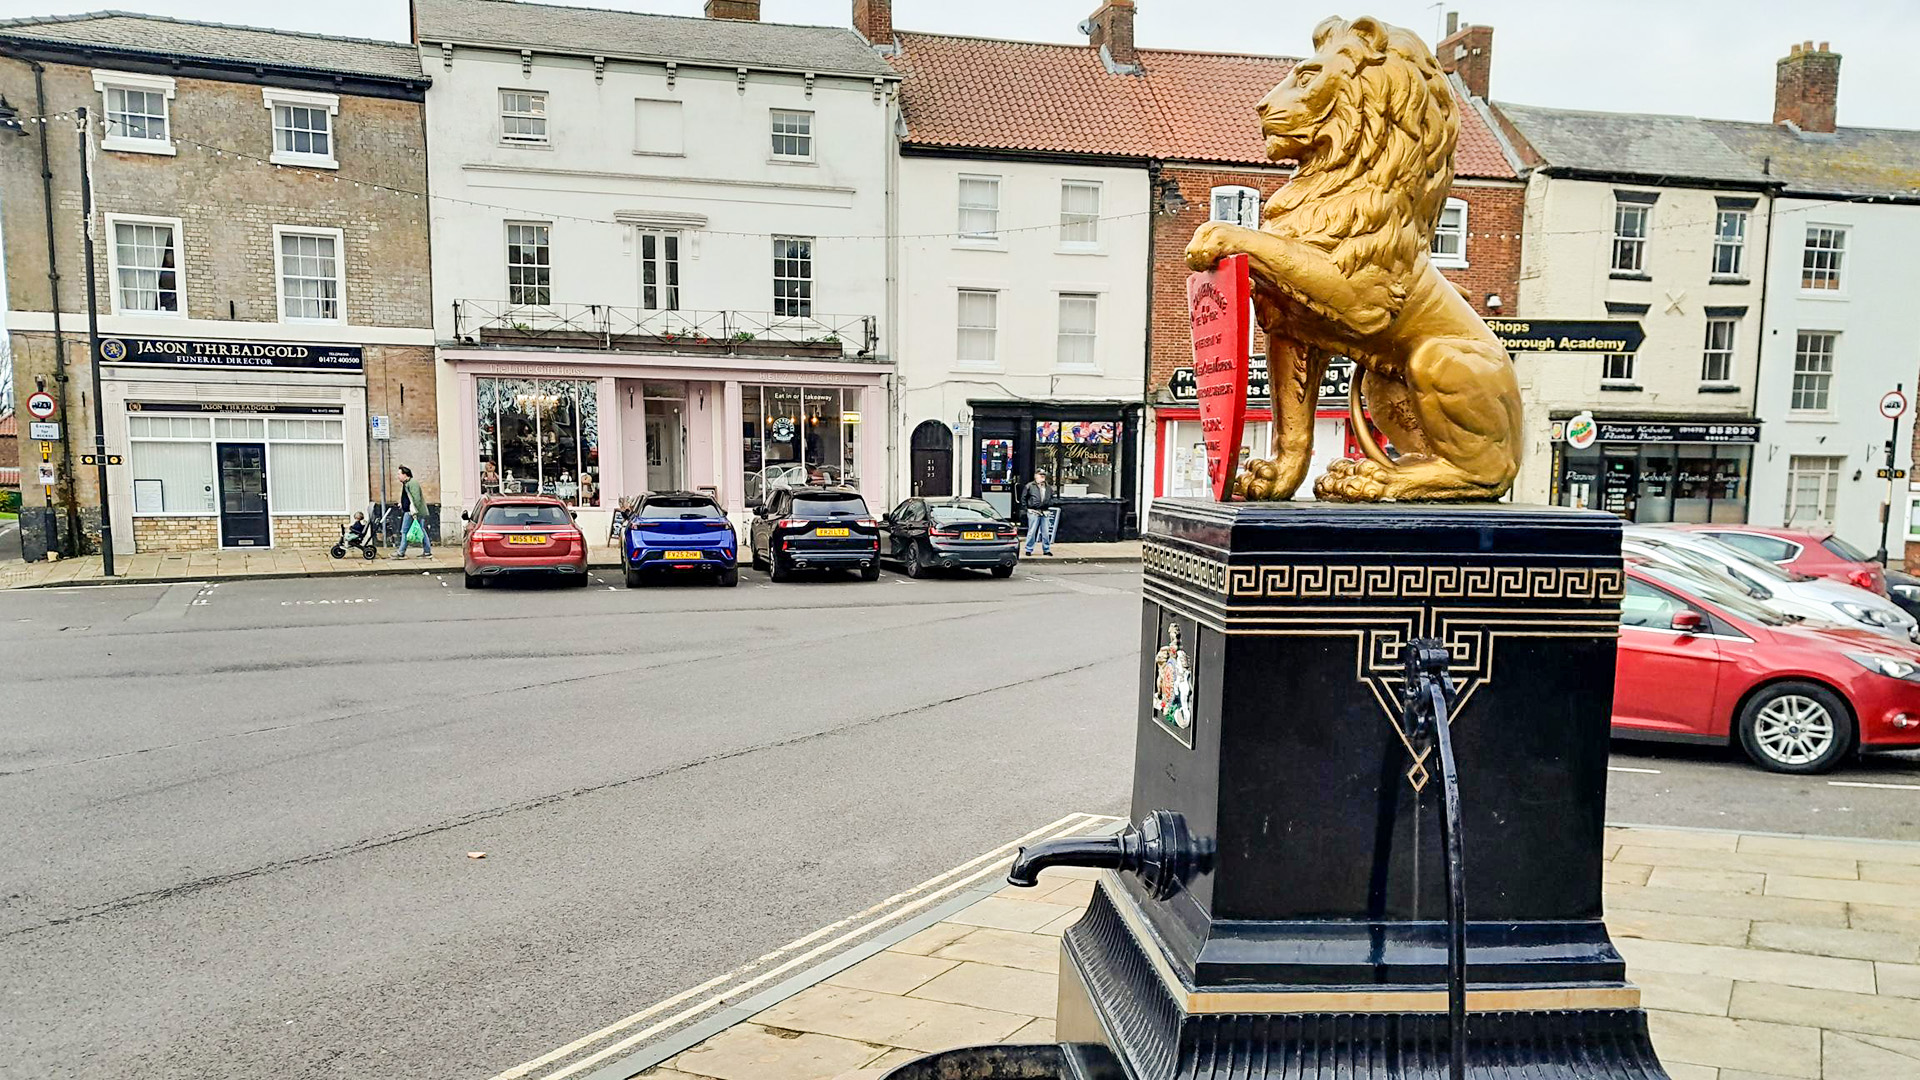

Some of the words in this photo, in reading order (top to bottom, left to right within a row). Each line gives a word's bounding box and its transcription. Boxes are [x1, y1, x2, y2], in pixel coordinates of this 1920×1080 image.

[1486, 320, 1530, 334] Shops
[137, 340, 187, 355] JASON
[193, 343, 309, 358] THREADGOLD
[1500, 337, 1556, 351] borough
[1558, 336, 1626, 351] Academy
[176, 355, 223, 364] FUNERAL
[226, 357, 273, 366] DIRECTOR
[318, 356, 337, 364] 01472
[489, 364, 506, 373] The
[508, 364, 533, 374] Little
[535, 365, 555, 375] Gift
[557, 366, 585, 375] House
[797, 374, 849, 382] KITCHEN
[804, 393, 833, 401] takeaway
[225, 403, 276, 411] THREADGOLD
[1636, 425, 1671, 433] Kebabs
[1725, 426, 1740, 435] 20
[1740, 426, 1756, 436] 20
[1084, 450, 1110, 459] Bakery
[1640, 471, 1672, 482] Kebabs
